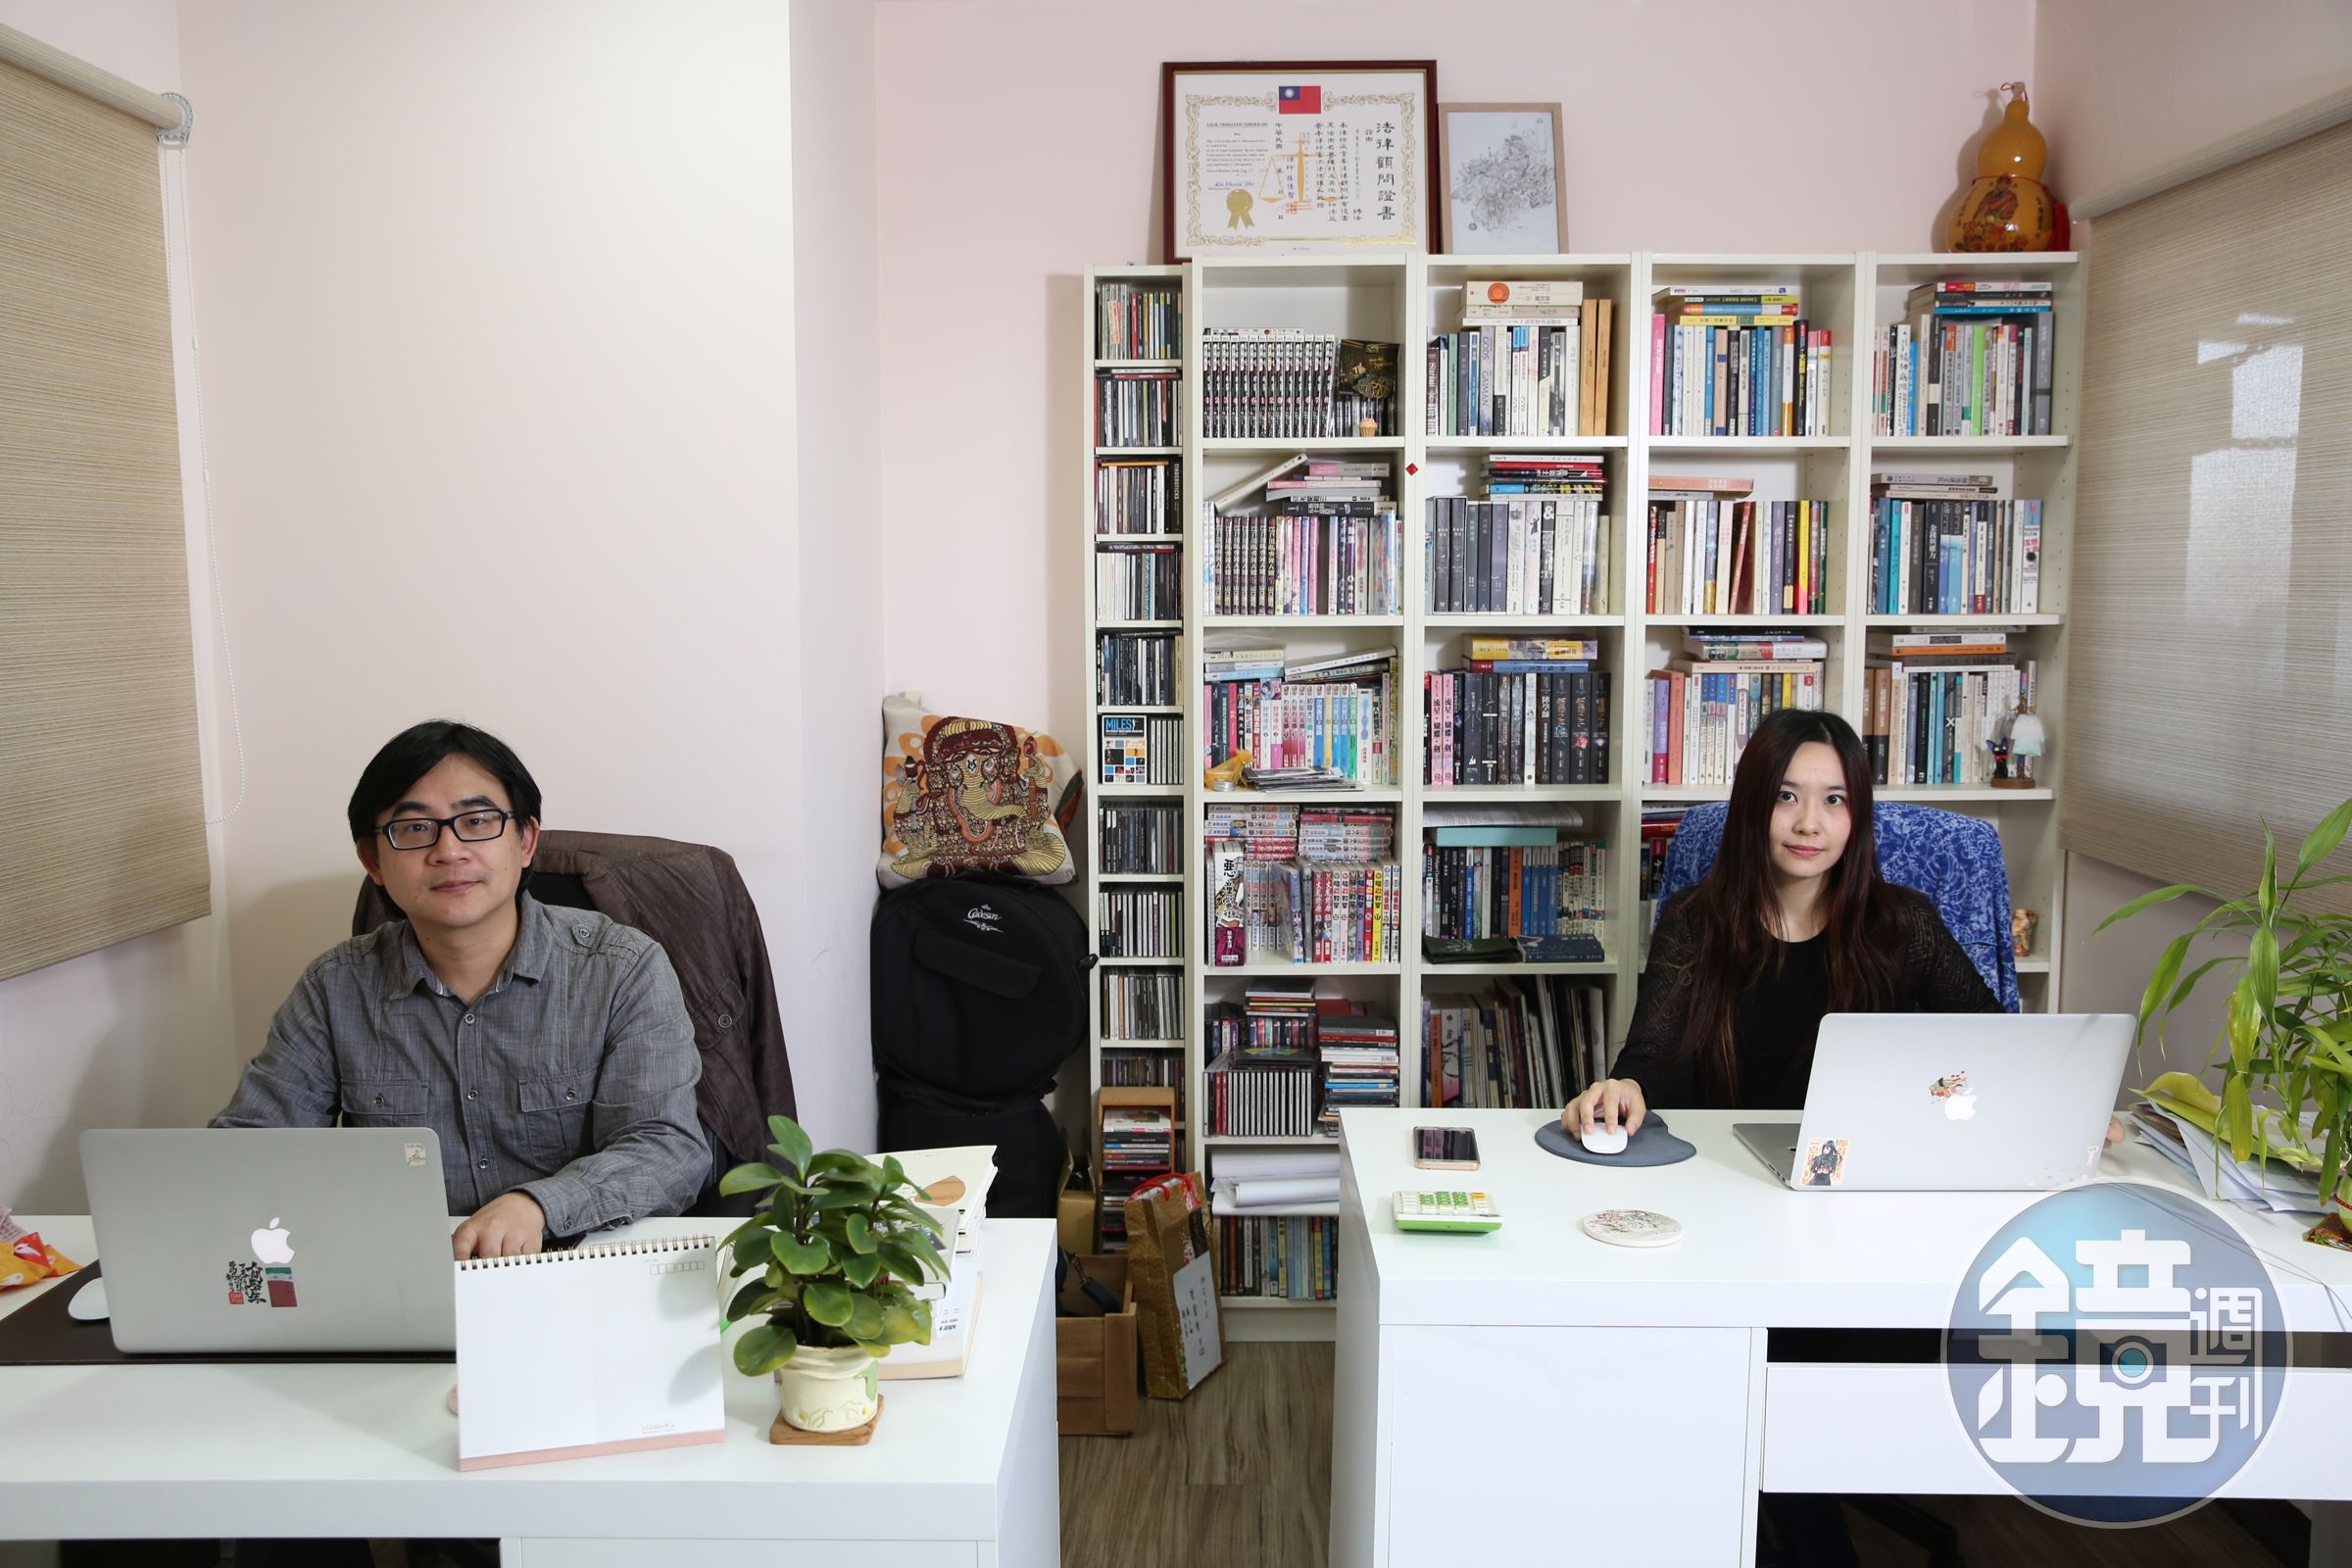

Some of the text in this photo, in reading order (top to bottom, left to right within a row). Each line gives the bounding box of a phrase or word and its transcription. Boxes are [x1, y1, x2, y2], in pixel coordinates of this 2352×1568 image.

[1376, 122, 1396, 220] 法律顧問證書
[1105, 718, 1132, 730] MILES
[967, 907, 1001, 920] Cadeson
